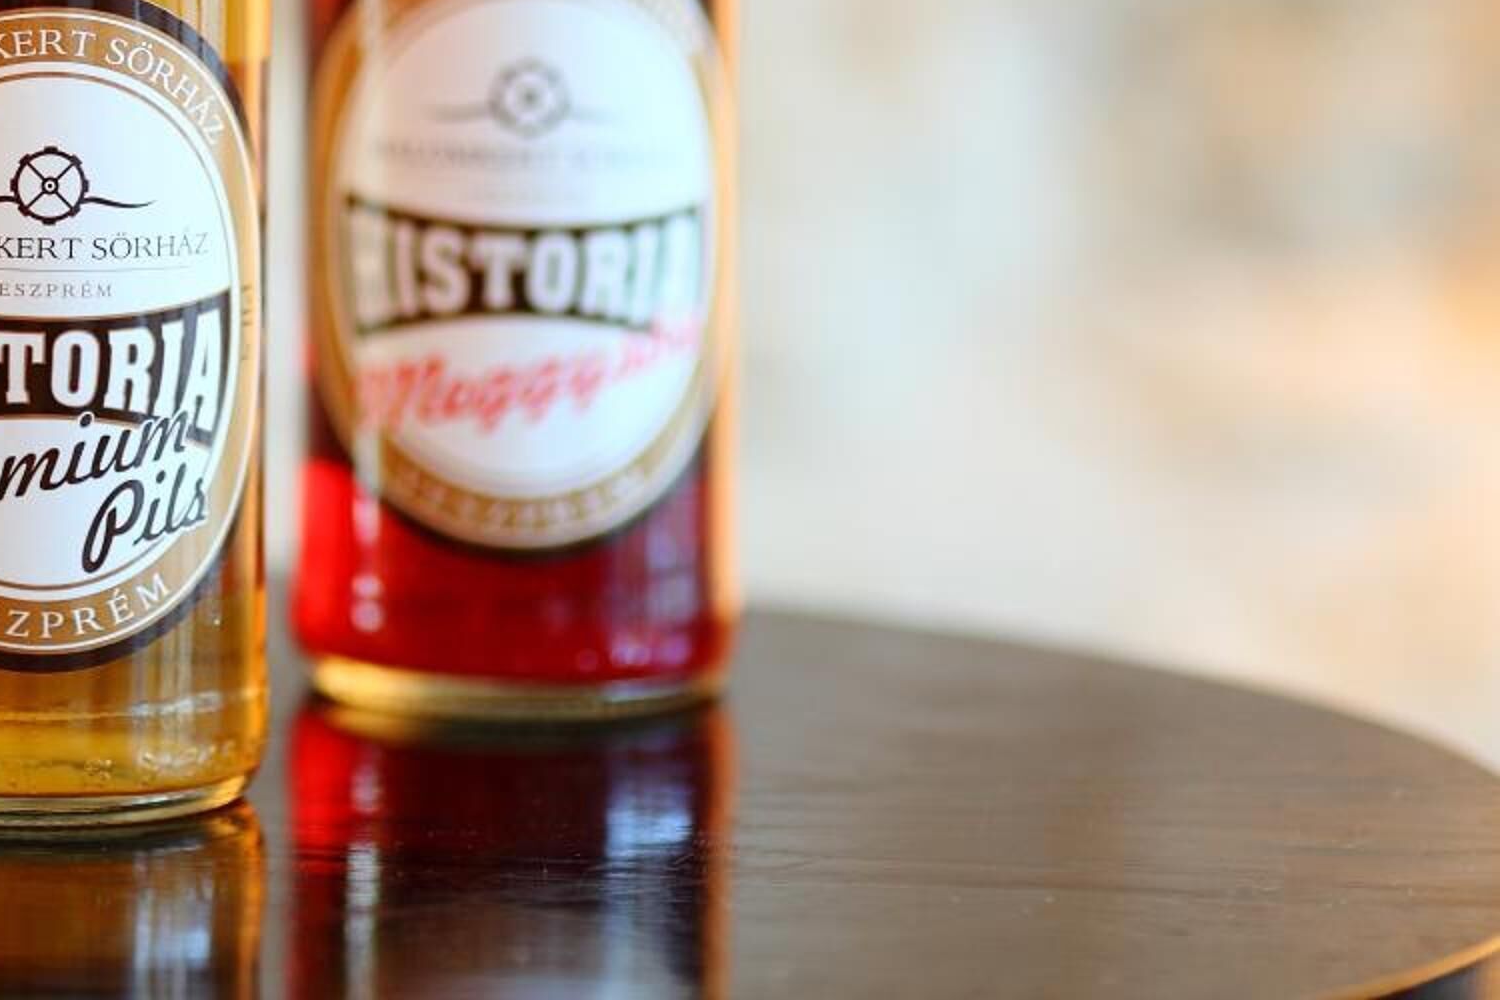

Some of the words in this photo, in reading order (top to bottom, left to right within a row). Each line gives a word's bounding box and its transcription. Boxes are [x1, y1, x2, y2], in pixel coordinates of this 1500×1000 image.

[105, 37, 228, 146] SÖRHÁZ
[91, 227, 209, 260] SÖRHÁZ
[81, 462, 206, 573] Pils
